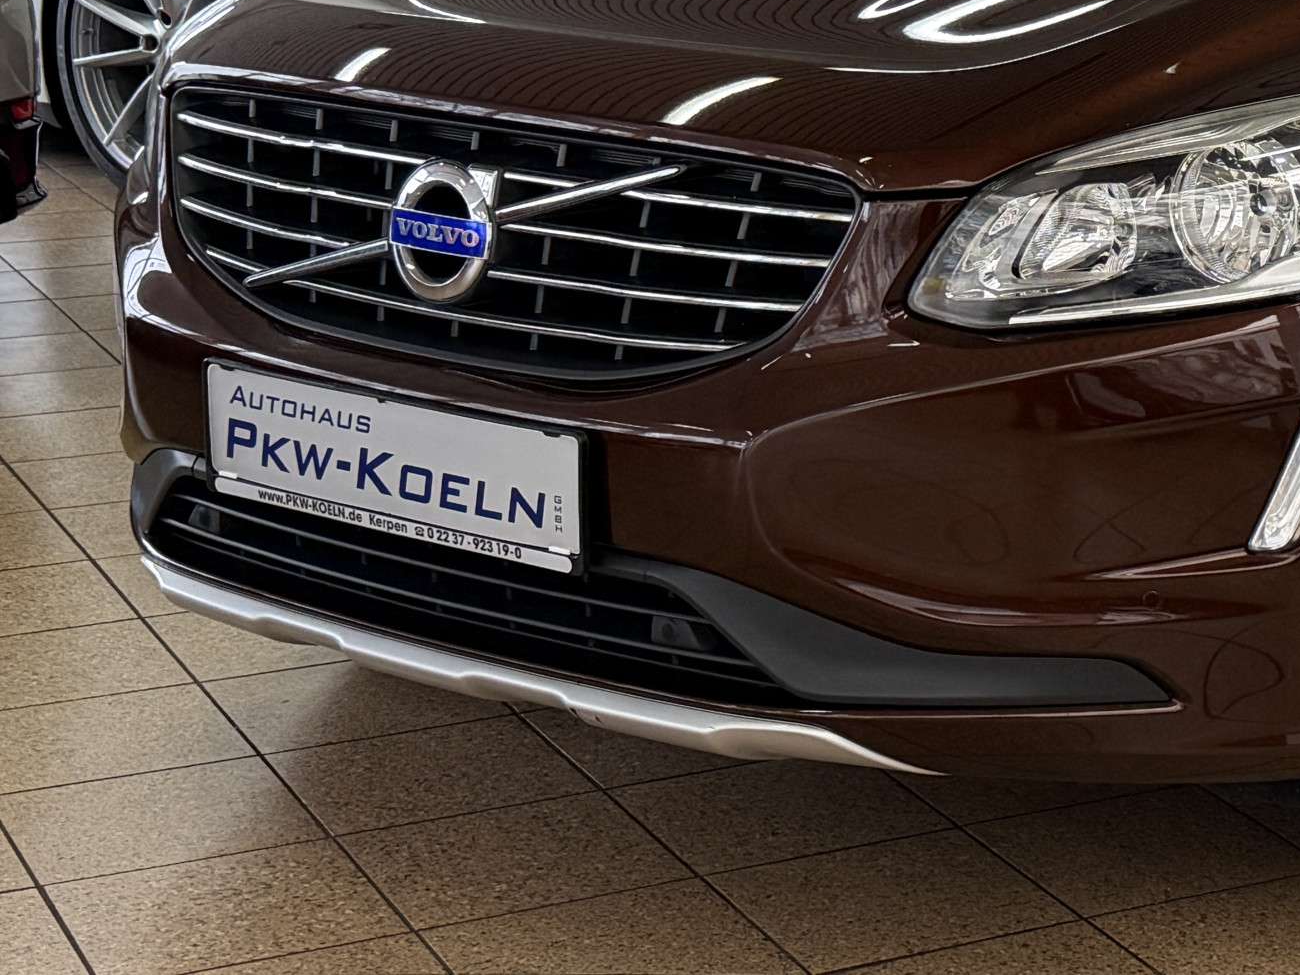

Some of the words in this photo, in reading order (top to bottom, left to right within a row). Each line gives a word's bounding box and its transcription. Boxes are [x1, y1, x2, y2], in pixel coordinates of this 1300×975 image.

[395, 217, 480, 248] VOLVO
[229, 385, 372, 434] AUTOHAUS
[226, 417, 546, 529] PKW-KOELN
[258, 489, 363, 523] www.PKW-KOELN.de
[368, 513, 408, 534] Kerpen
[553, 495, 563, 533] GMBH
